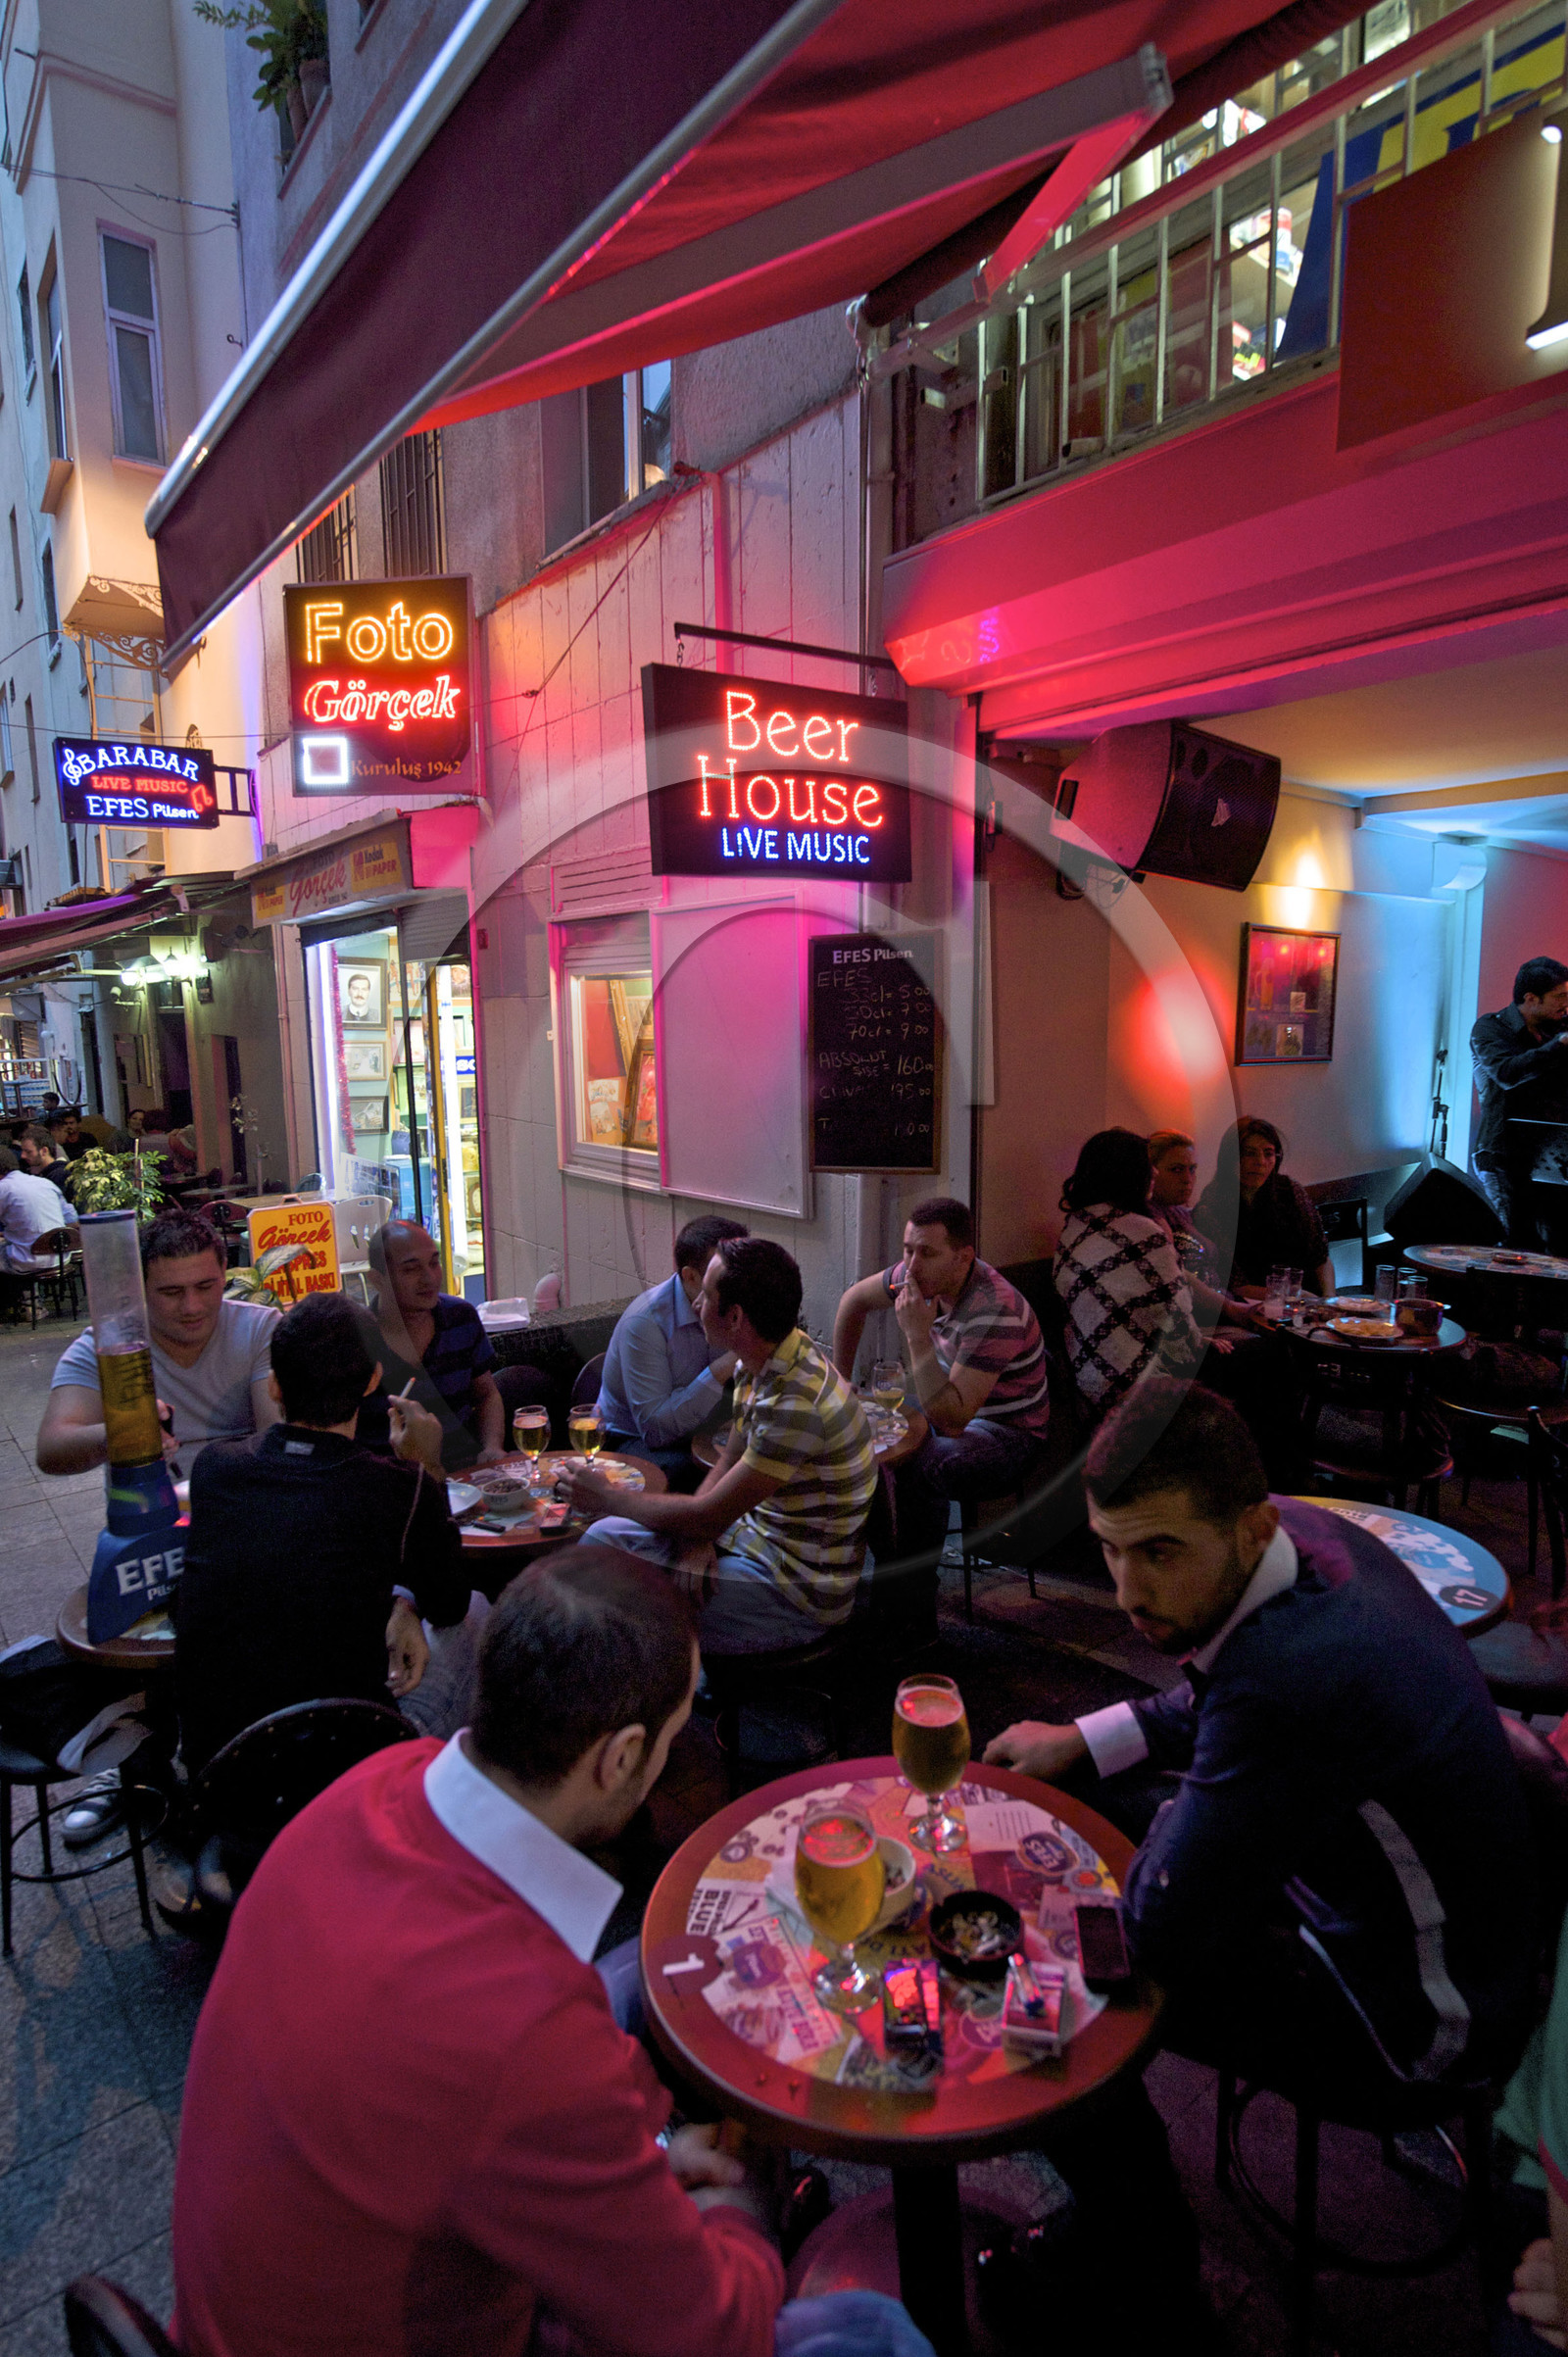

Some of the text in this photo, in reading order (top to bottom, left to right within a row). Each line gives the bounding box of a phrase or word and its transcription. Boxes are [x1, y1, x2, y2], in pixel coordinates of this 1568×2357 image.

[305, 601, 454, 664] Foto
[303, 674, 462, 732] Görçek
[725, 690, 859, 762] Beer
[75, 745, 200, 782] BARABAR
[427, 760, 463, 775] 1942
[90, 775, 189, 794] LIVE MUSIC
[697, 754, 884, 828] House
[84, 794, 200, 820] EFES Pilsen
[721, 826, 871, 864] LIVE MUSIC
[833, 948, 914, 964] EFES Pilsen
[817, 967, 872, 988] EFES
[818, 1050, 888, 1069] ABSOLUT
[288, 1210, 324, 1226] FOTO
[305, 1272, 336, 1293] BASKI
[115, 1547, 186, 1596] EFE
[1451, 1588, 1489, 1607] 17
